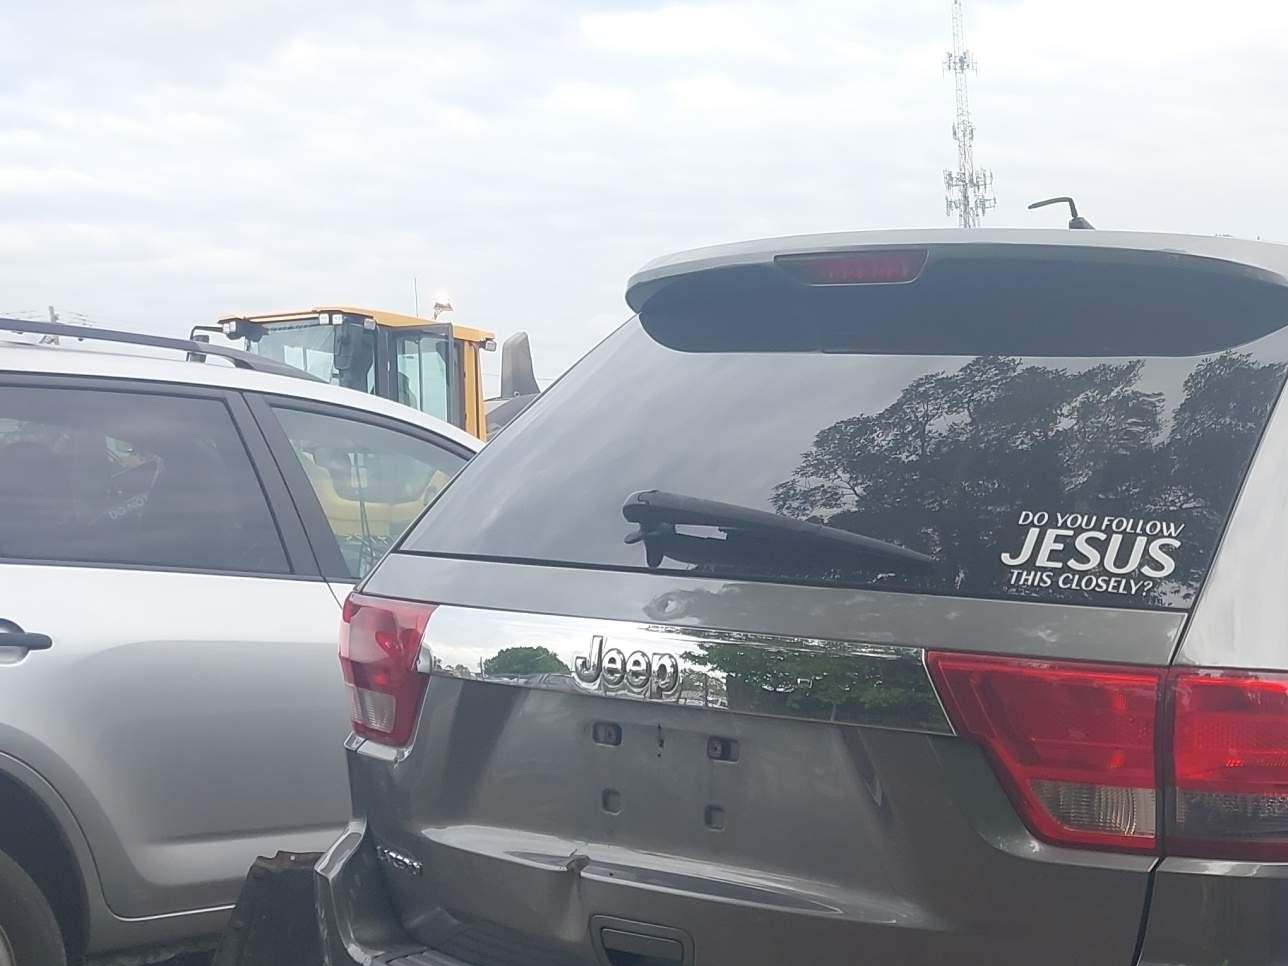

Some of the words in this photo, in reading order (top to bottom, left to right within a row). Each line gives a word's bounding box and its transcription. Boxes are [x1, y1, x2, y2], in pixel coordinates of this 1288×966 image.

[1018, 511, 1049, 526] DO
[1056, 512, 1097, 530] YOU
[1101, 516, 1185, 537] FOLLOW
[1000, 527, 1182, 578] JESUS
[1009, 569, 1054, 588] THIS
[1058, 572, 1153, 597] CLOSELY?
[574, 634, 679, 699] Jeep
